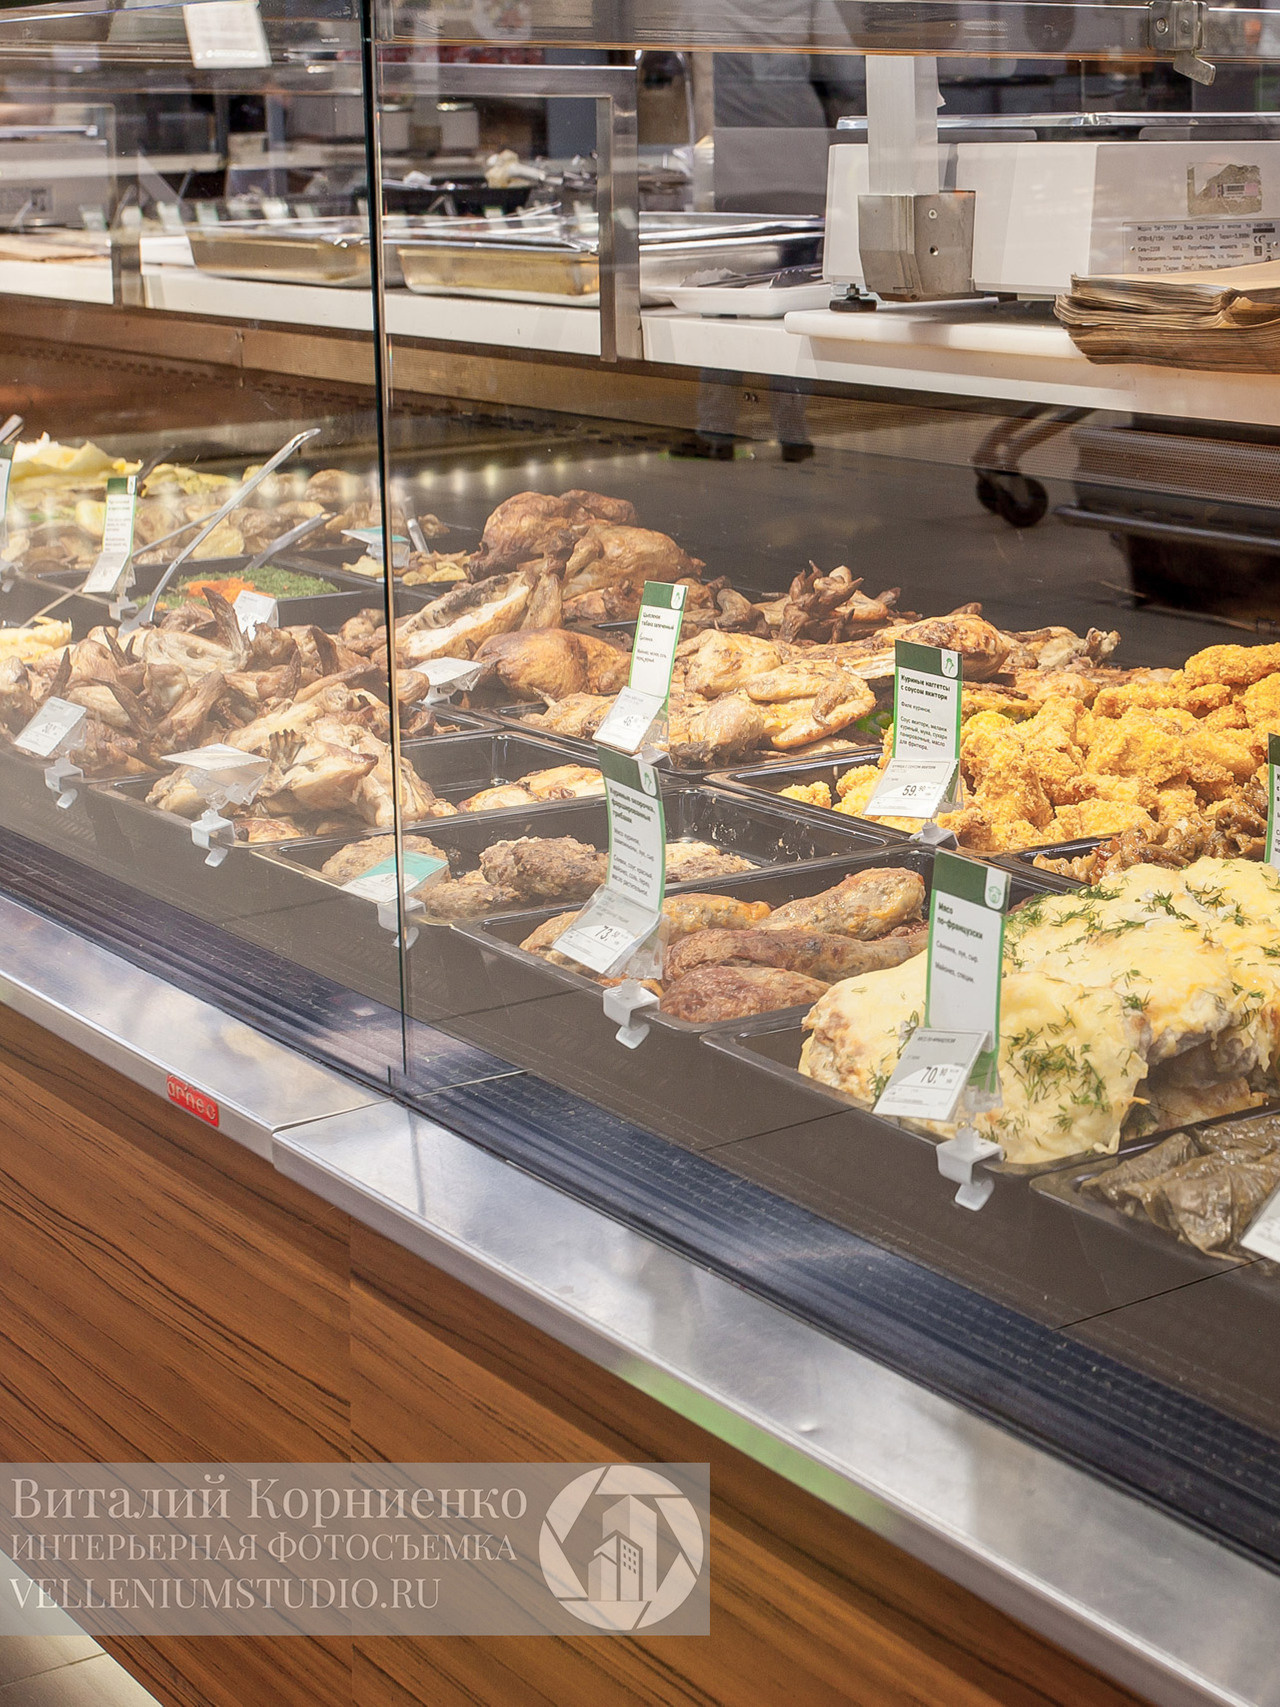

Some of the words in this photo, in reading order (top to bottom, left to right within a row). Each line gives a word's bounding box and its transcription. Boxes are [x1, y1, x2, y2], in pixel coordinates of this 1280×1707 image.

[901, 675, 924, 686] Куриные
[926, 682, 950, 691] наггетсы
[905, 686, 924, 695] соусом
[938, 902, 953, 915] Мясо
